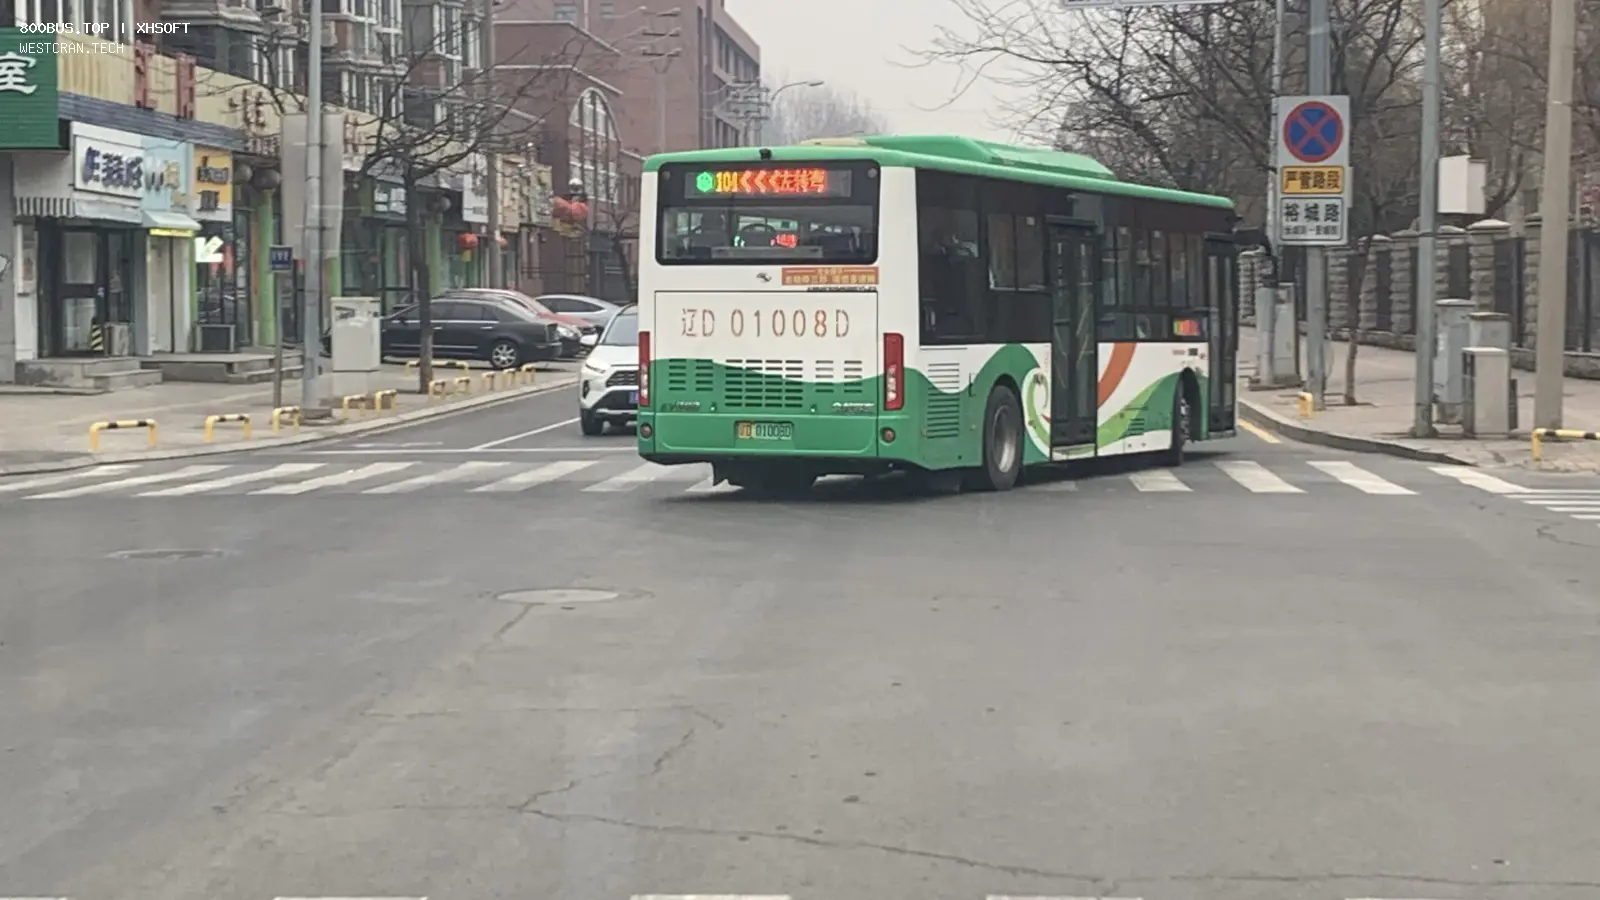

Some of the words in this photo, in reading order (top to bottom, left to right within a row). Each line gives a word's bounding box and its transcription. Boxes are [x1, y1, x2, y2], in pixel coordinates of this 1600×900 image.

[0, 51, 38, 95] 室
[1284, 170, 1340, 190] 严管路段
[1283, 202, 1340, 223] 裕城路
[681, 308, 715, 338] 辽D
[730, 308, 850, 338] 01008D
